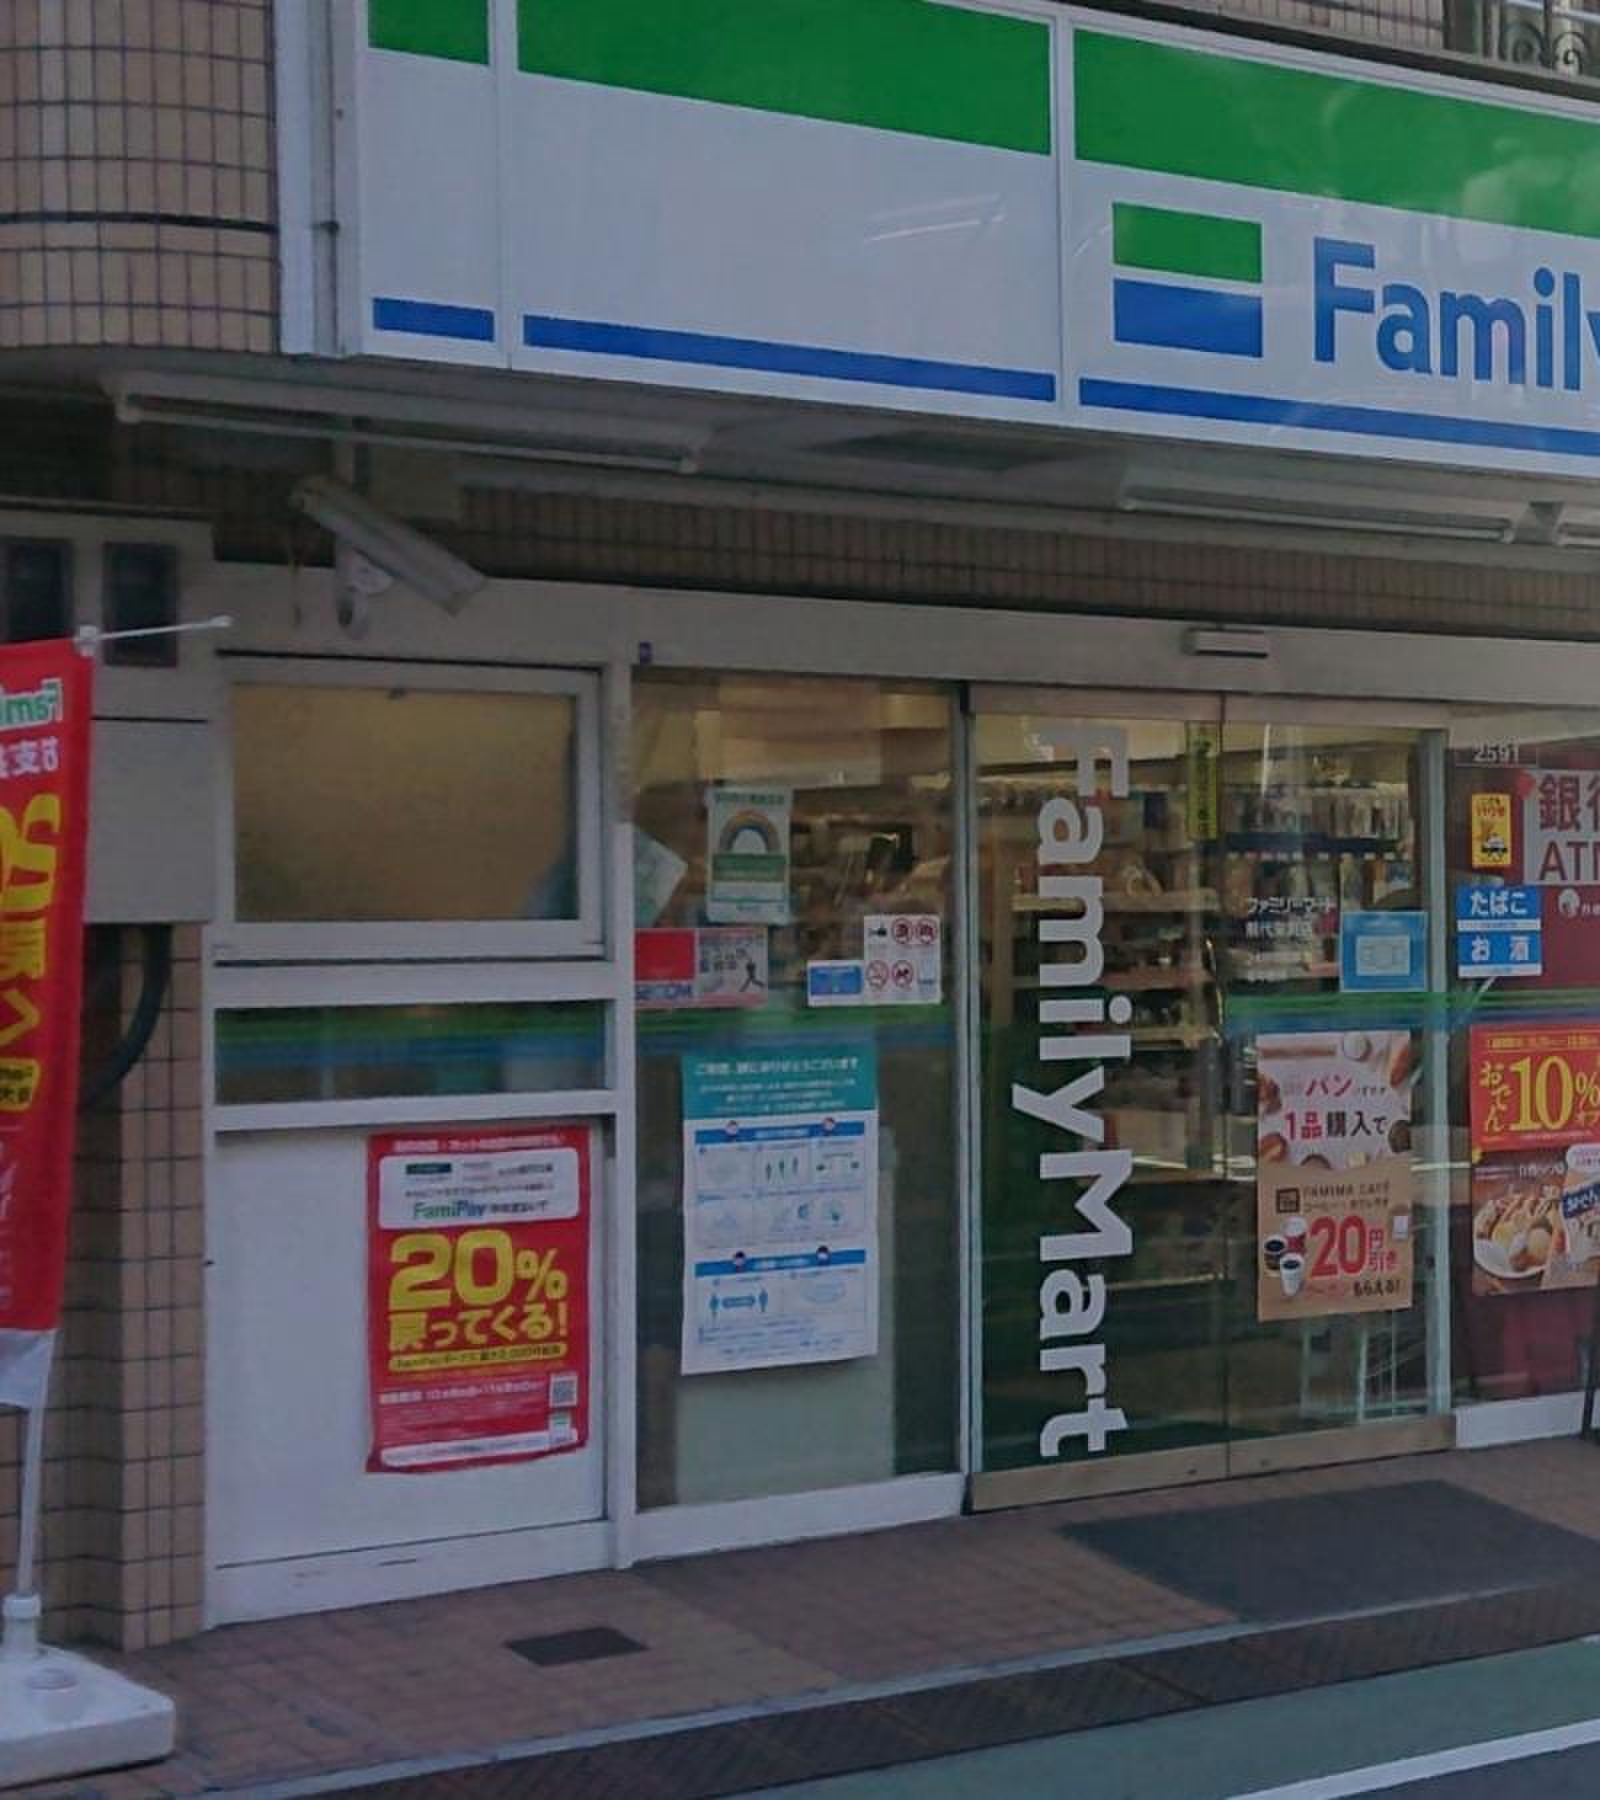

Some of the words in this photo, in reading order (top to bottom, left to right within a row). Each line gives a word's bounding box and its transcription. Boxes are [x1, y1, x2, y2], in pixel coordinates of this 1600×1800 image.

[1473, 742, 1520, 763] 2591
[1470, 890, 1528, 918] たばこ
[1011, 724, 1133, 1458] FamilyMart
[1305, 1074, 1353, 1097] パン
[1479, 1060, 1513, 1132] おでん
[412, 1199, 488, 1220] FamiPay
[387, 1229, 568, 1311] 20%
